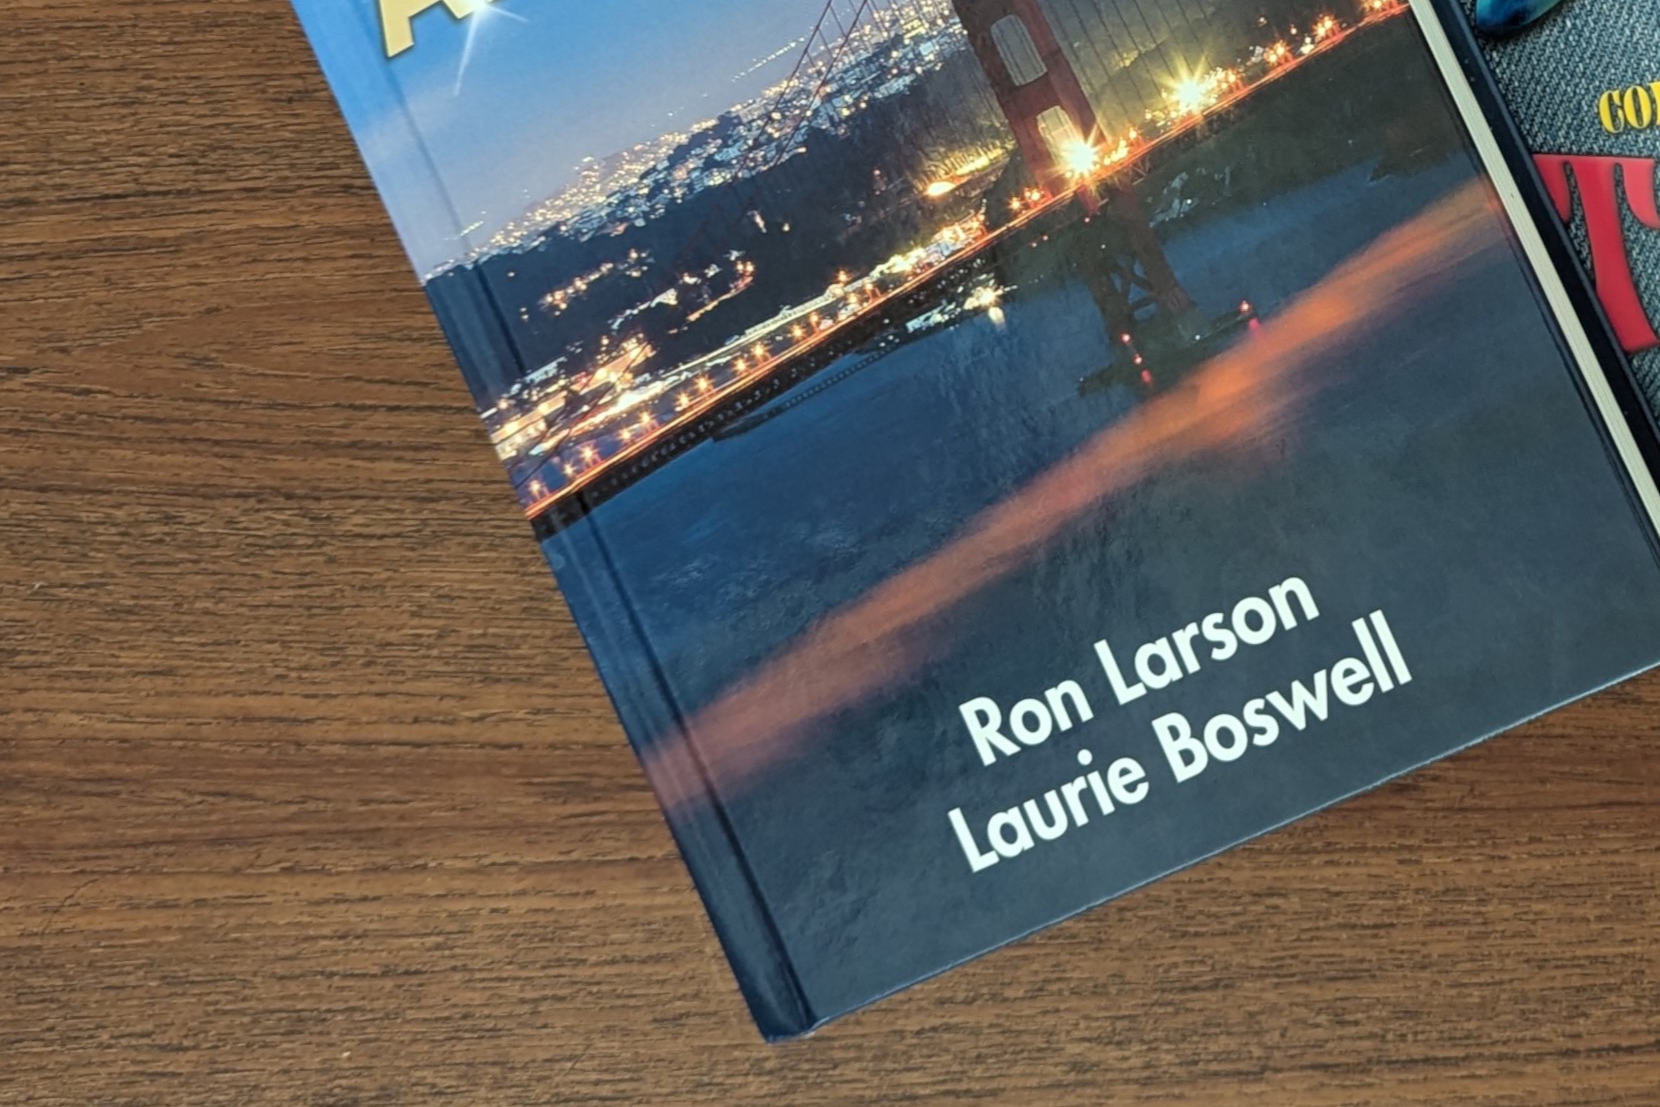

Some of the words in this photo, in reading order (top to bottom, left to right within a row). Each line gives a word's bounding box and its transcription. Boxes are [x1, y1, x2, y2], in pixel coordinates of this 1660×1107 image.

[947, 748, 1150, 874] Laurie
[1151, 608, 1413, 783] Boswell
[959, 679, 1094, 767] Ron
[1093, 576, 1320, 705] Larson
